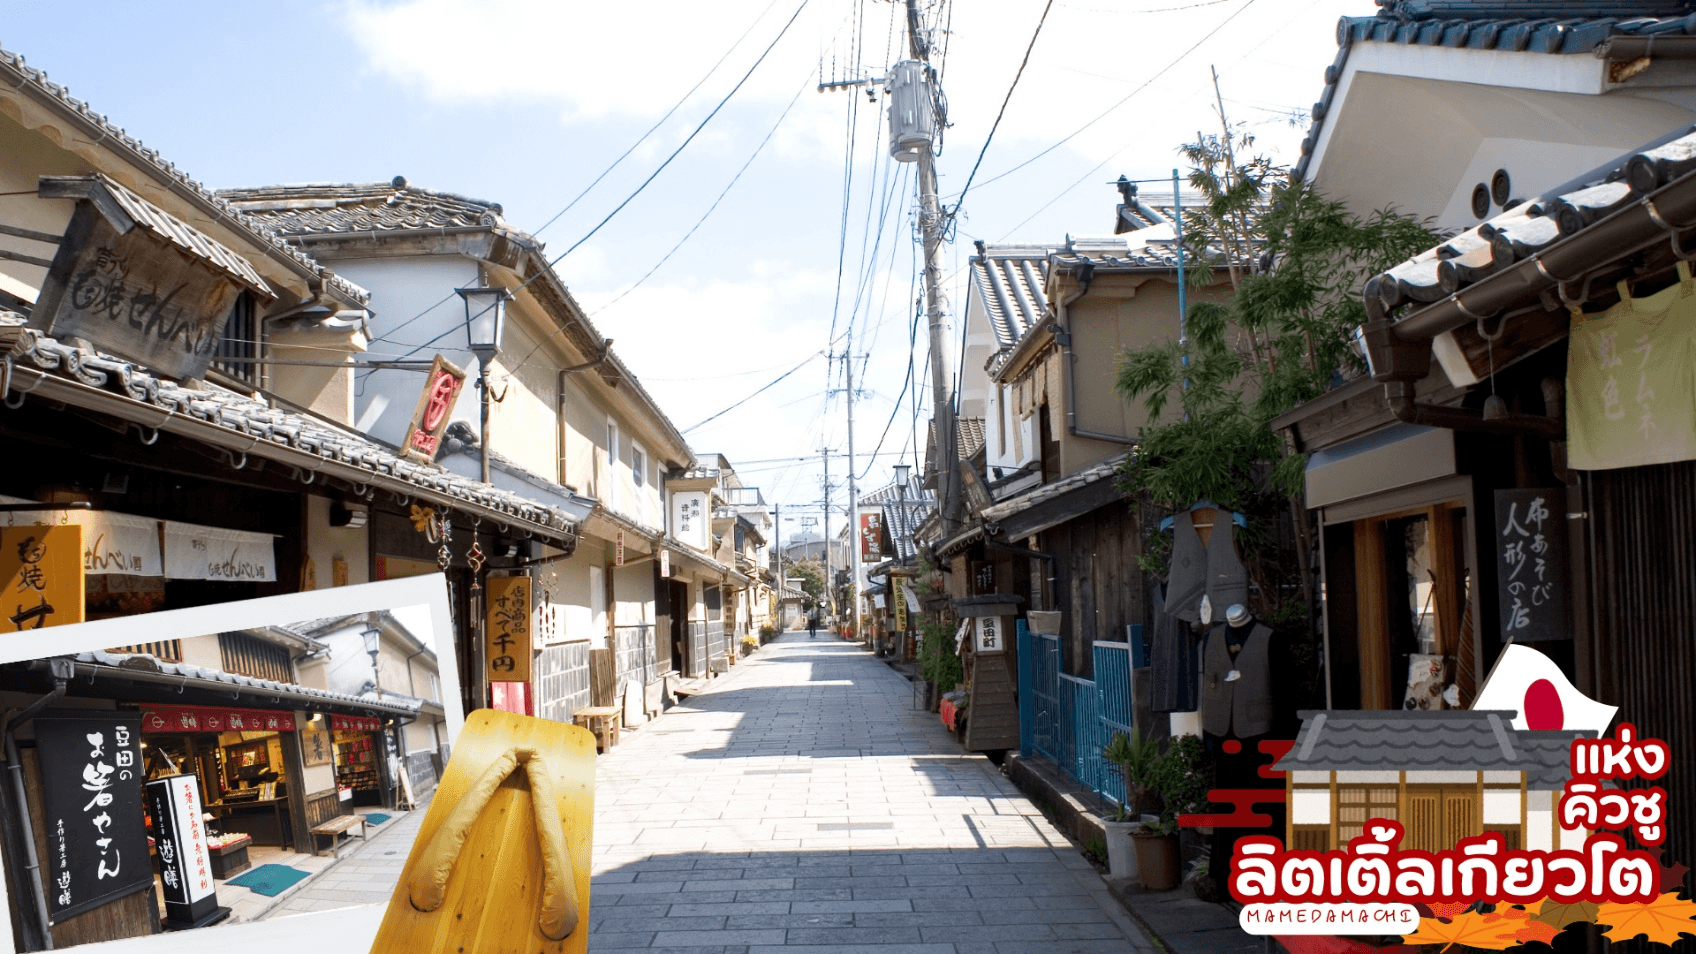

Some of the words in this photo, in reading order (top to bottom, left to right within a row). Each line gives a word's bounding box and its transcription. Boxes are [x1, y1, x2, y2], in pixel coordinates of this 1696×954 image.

[1502, 502, 1531, 631] 人形の店
[1525, 497, 1553, 606] 布あそび
[491, 595, 516, 672] すべて千円
[510, 585, 527, 634] 店内商品
[982, 617, 996, 649] 豆田町
[115, 725, 134, 781] 豆田の
[82, 731, 121, 880] お箸やさん
